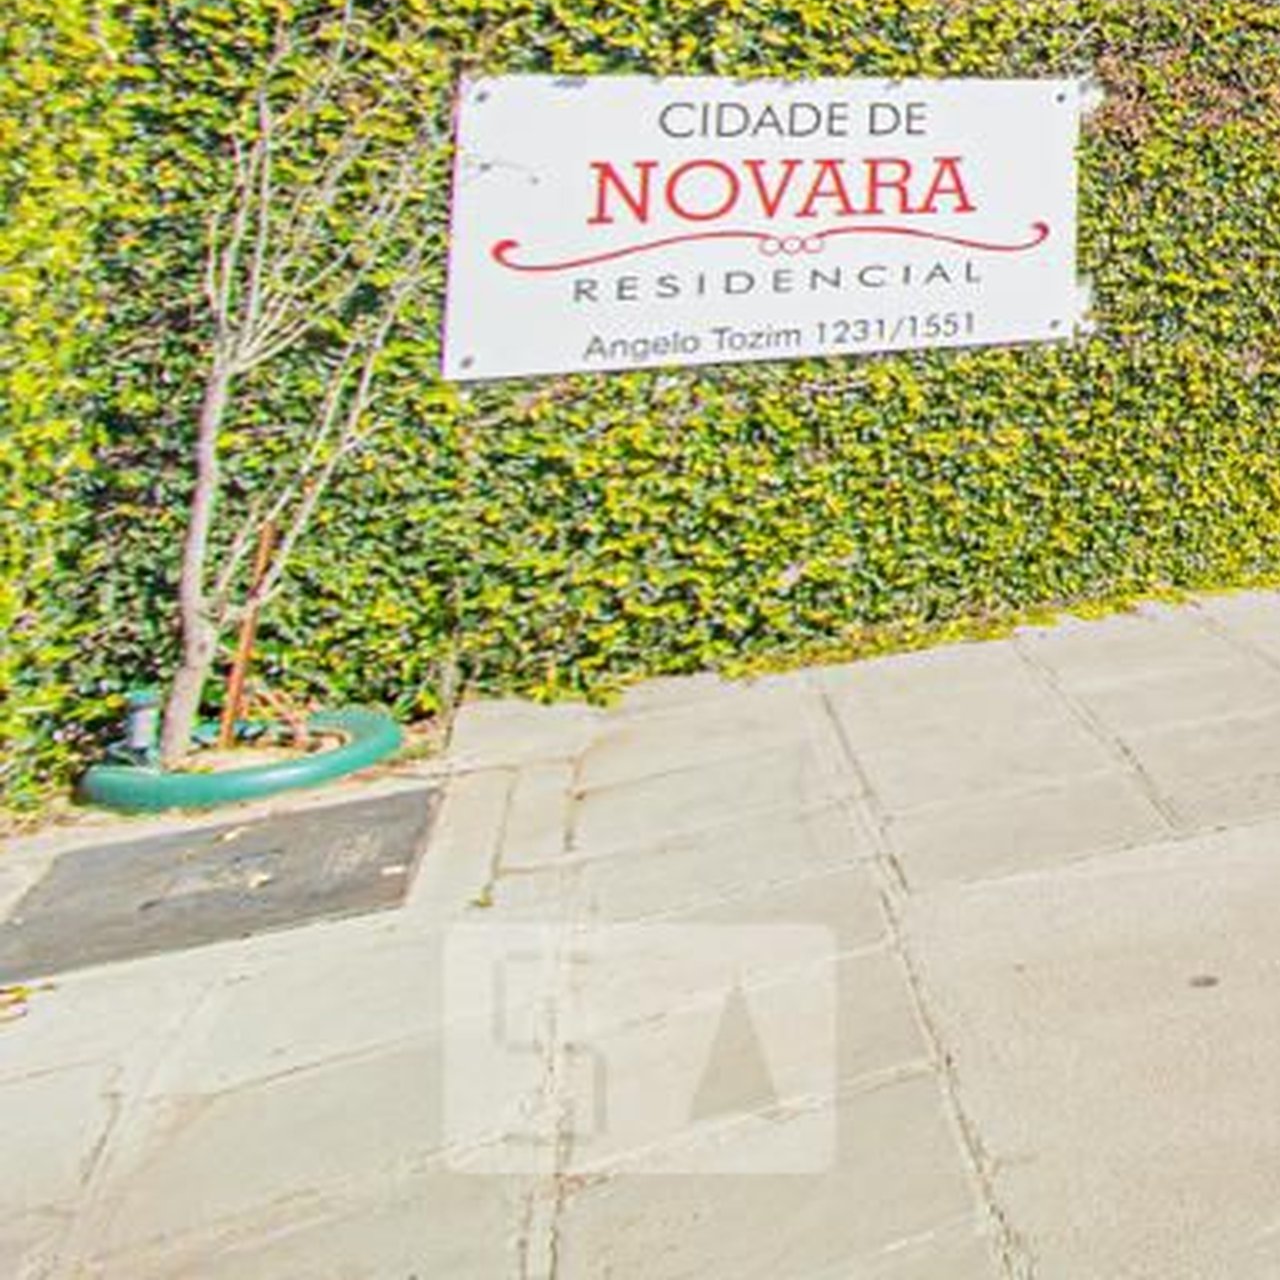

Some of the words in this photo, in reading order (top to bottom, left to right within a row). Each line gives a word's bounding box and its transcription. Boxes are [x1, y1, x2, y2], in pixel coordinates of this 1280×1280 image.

[658, 101, 849, 139] CIDADE
[868, 101, 928, 137] DE
[585, 155, 978, 227] NOVARA
[572, 260, 984, 304] RESIDENCIAL
[582, 332, 701, 361] Angelo
[711, 325, 802, 351] Tozim
[817, 311, 975, 346] 1231/1551
